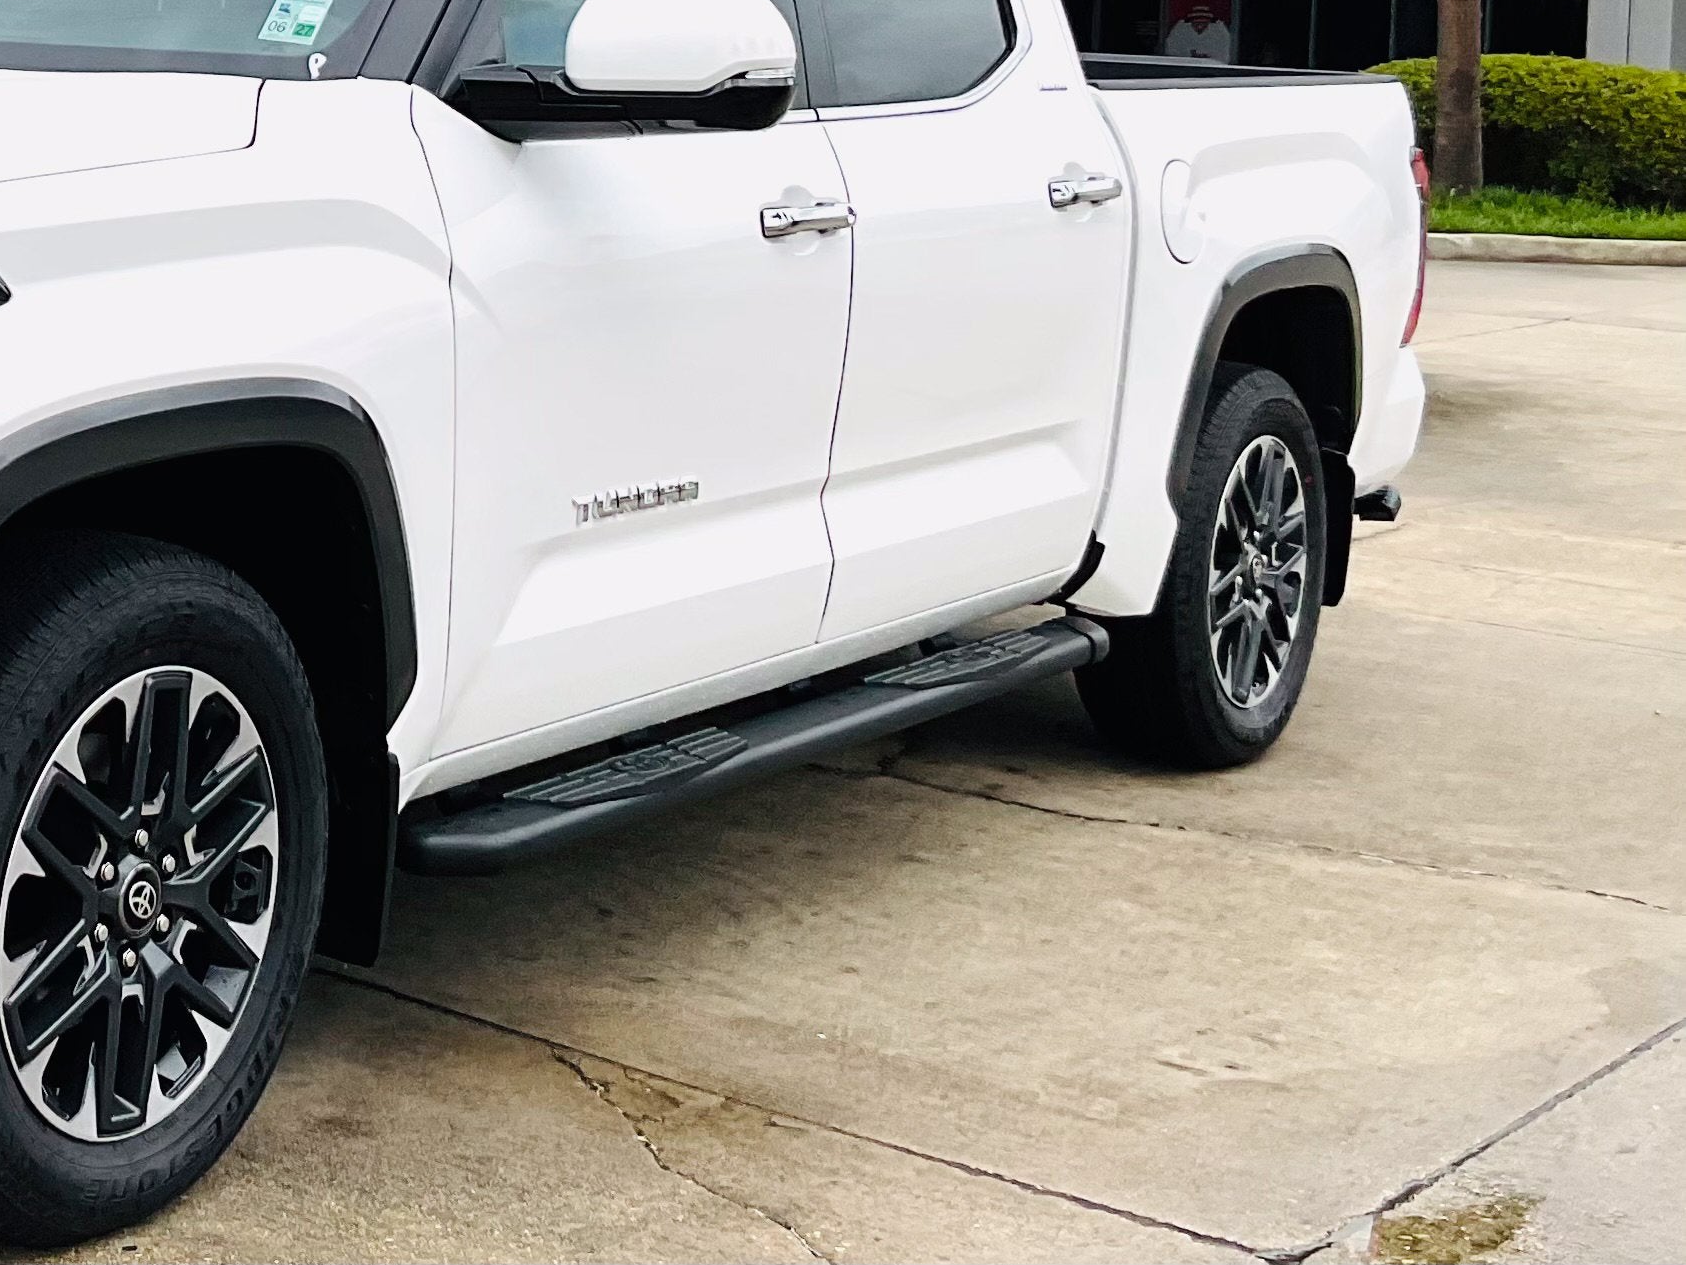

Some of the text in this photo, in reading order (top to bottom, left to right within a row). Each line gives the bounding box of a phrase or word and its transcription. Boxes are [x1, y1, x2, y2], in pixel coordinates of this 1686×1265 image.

[267, 20, 315, 36] 06 27
[571, 476, 700, 526] TUNDRA
